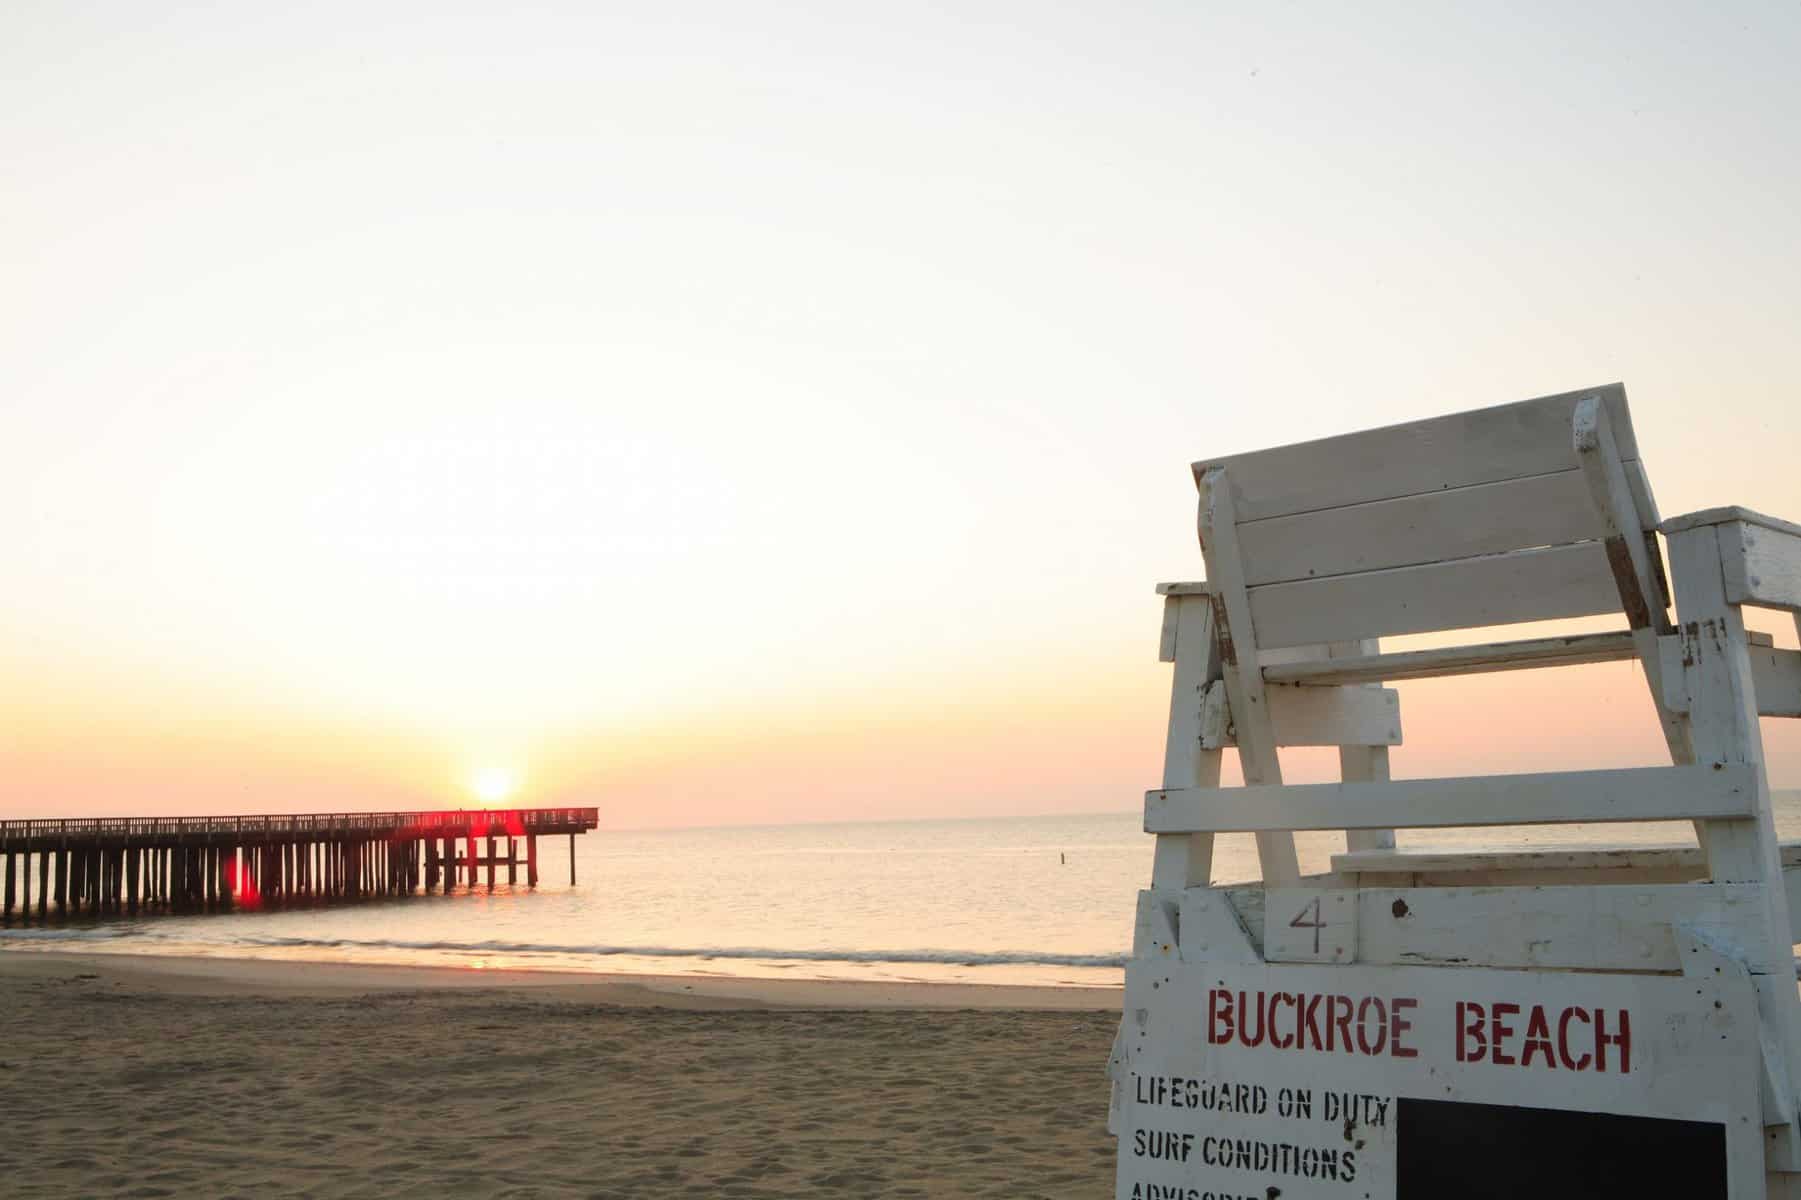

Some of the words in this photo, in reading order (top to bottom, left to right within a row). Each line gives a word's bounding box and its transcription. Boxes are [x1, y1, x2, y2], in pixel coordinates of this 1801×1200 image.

[1289, 896, 1327, 954] 4
[1207, 989, 1418, 1058] BUCKROE
[1455, 1001, 1631, 1073] BEACH
[1136, 1075, 1267, 1115] LIFEGUARD
[1278, 1087, 1312, 1120] ON
[1324, 1091, 1390, 1127] DUTY
[1133, 1128, 1195, 1163] SURF
[1203, 1136, 1356, 1183] CONDITIONS
